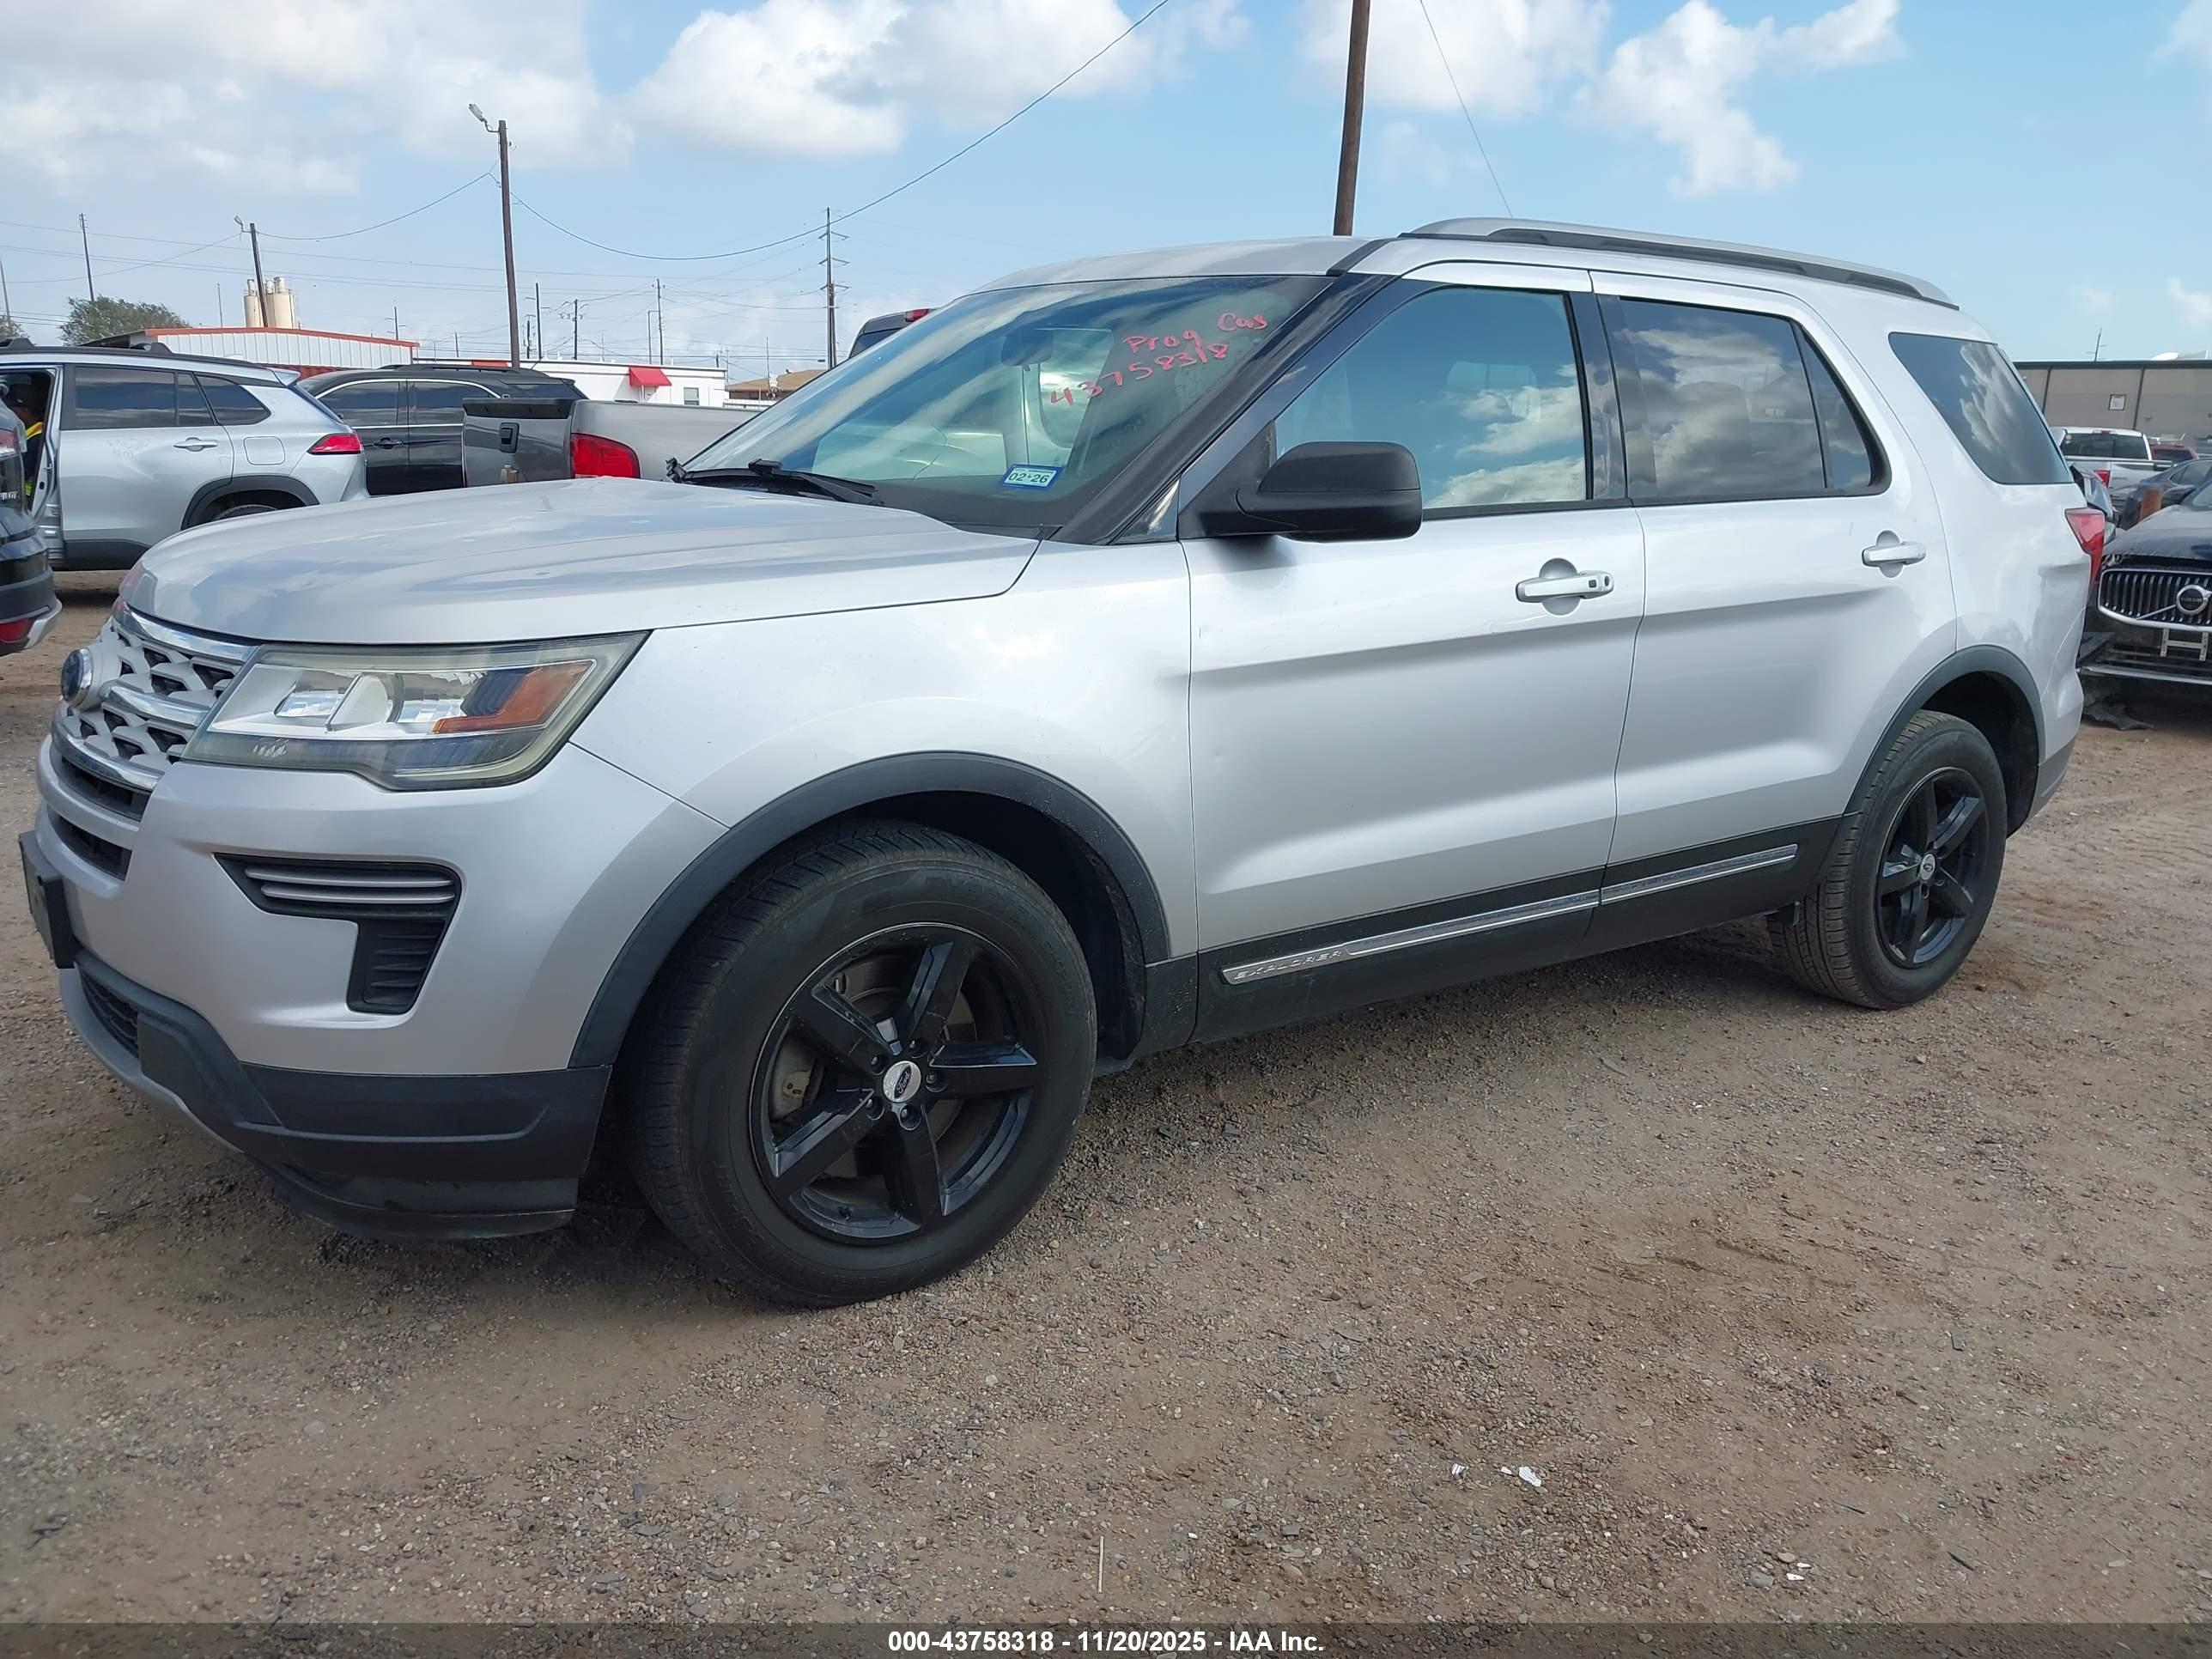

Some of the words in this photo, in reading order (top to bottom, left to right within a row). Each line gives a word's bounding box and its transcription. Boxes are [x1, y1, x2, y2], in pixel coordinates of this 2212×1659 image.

[1122, 330, 1204, 354] Prog
[1050, 343, 1228, 405] 43758318
[1233, 950, 1342, 980] EXPLORER
[896, 1071, 910, 1094] Ford
